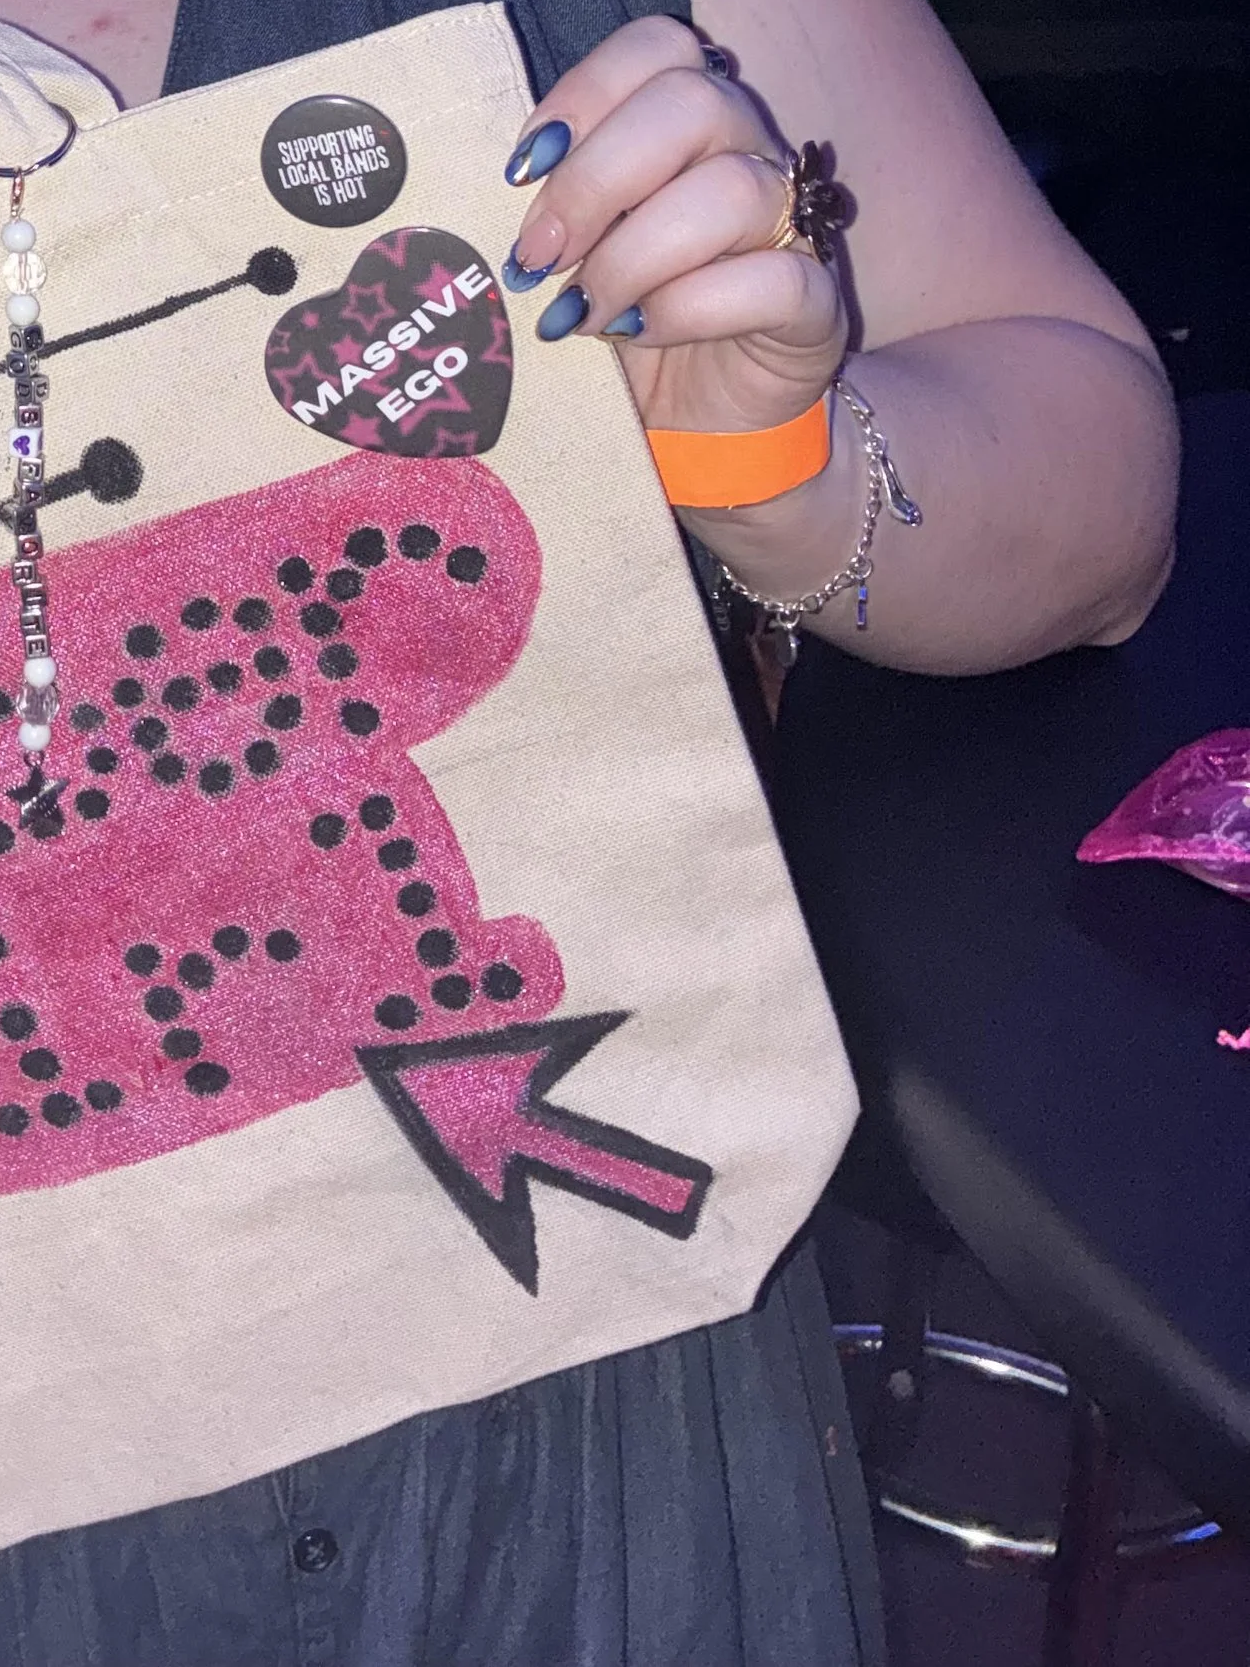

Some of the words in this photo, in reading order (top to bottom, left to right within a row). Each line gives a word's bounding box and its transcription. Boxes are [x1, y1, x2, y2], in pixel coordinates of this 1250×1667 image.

[277, 124, 376, 166] SUPPORTING
[278, 160, 333, 190] LOCAL
[332, 146, 390, 181] BANDS
[313, 184, 332, 206] IS
[333, 177, 368, 203] HOT
[291, 263, 493, 426] MASSIVE
[376, 346, 469, 423] EGO
